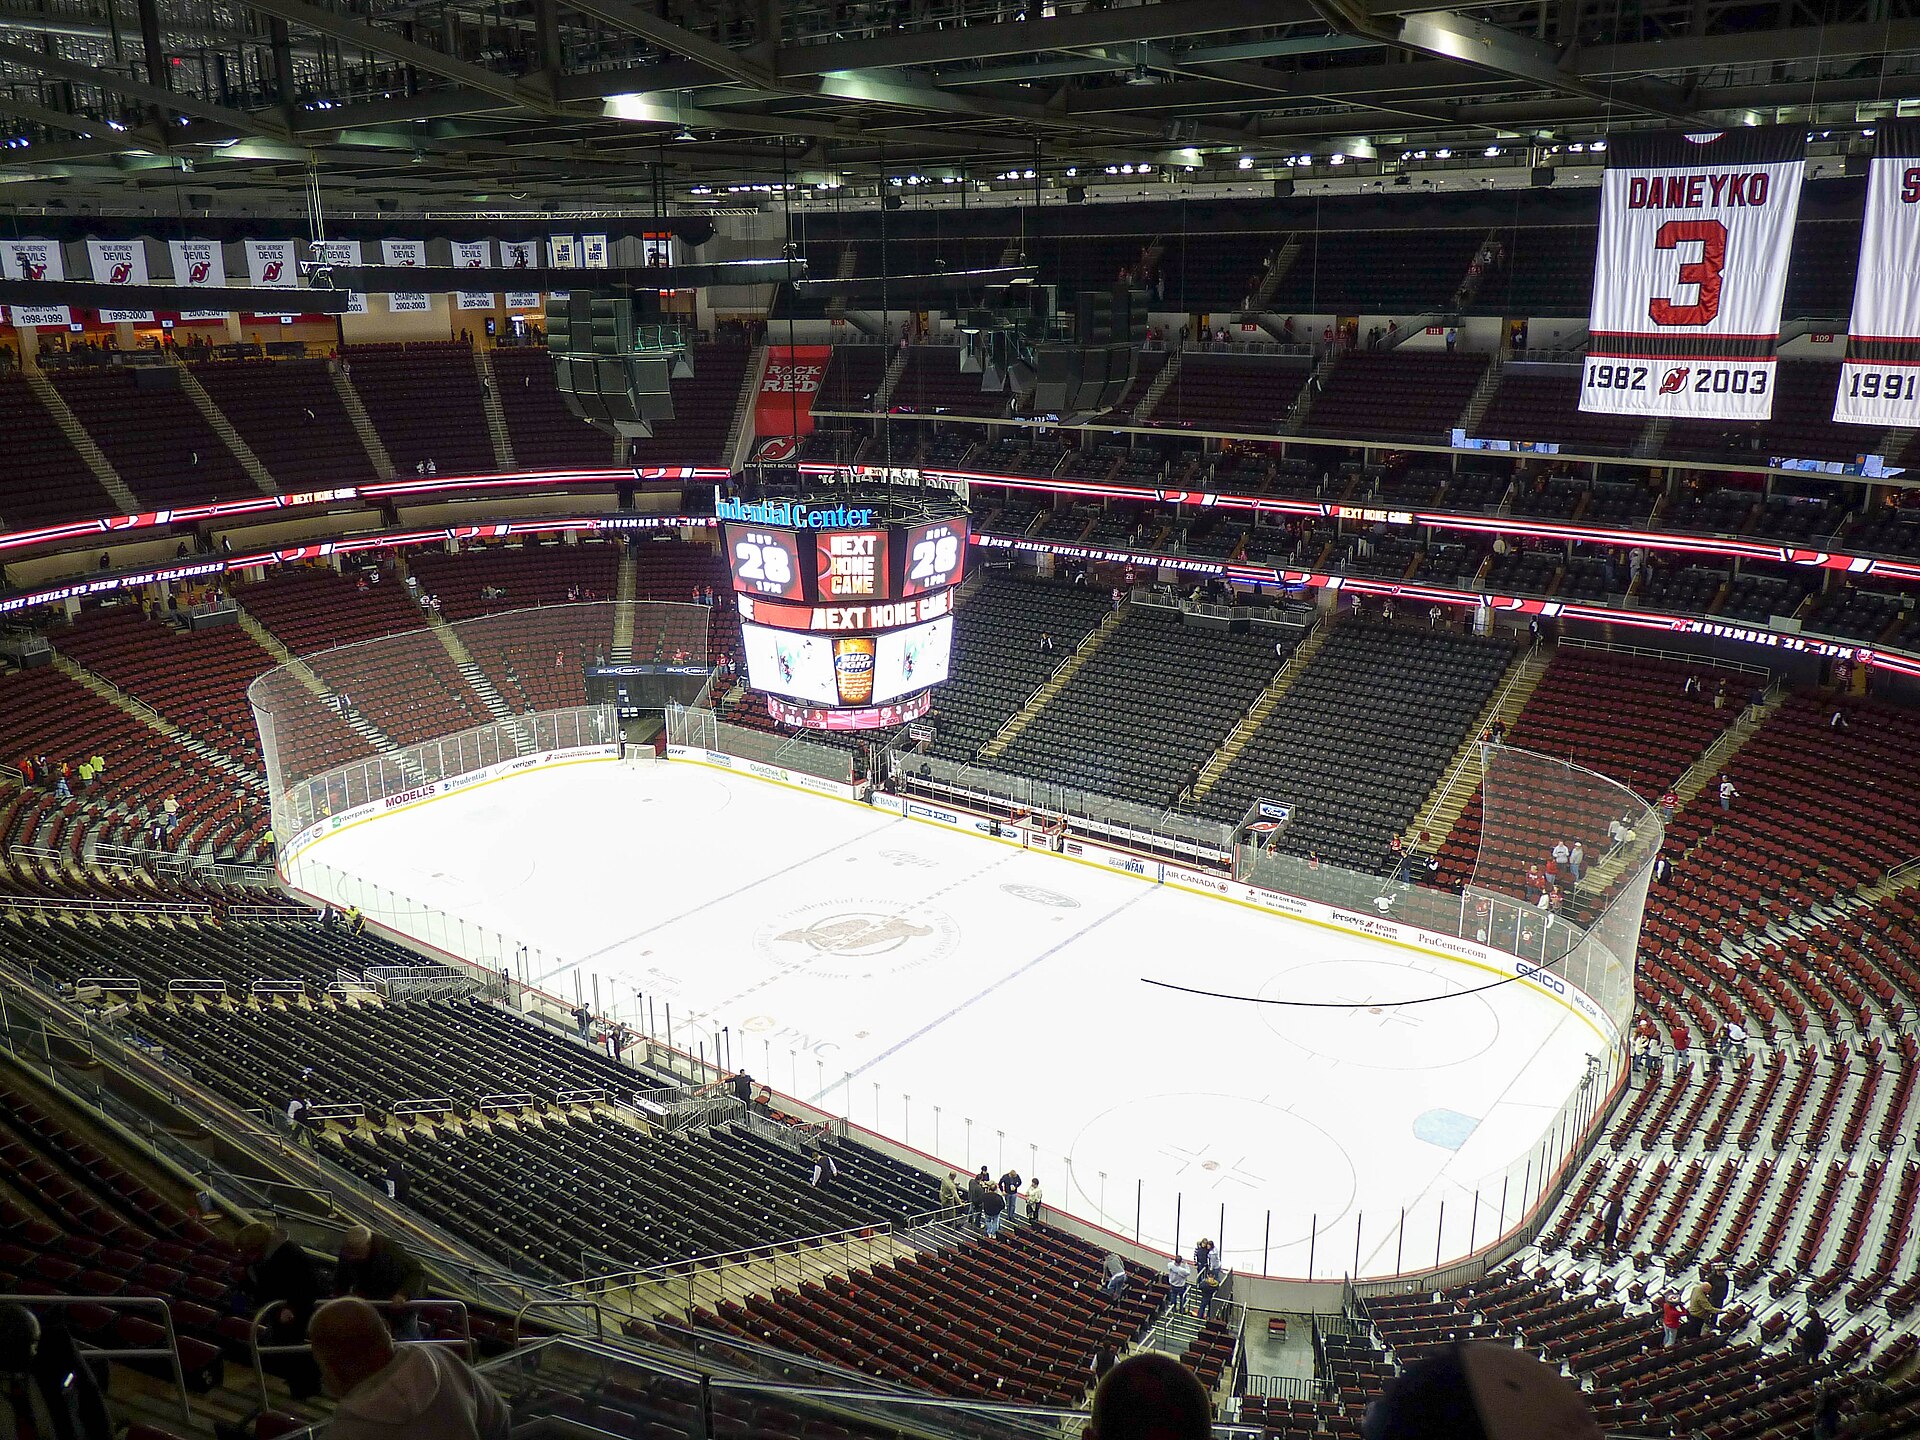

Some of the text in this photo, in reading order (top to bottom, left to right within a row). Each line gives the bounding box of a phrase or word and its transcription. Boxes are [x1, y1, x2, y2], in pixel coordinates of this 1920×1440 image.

[1629, 173, 1769, 209] DANEYKO
[104, 252, 132, 261] DEVILS
[184, 251, 210, 260] DEVILS
[258, 251, 283, 260] DEVILS
[328, 251, 350, 259] DEVILS
[394, 250, 415, 258] DEVILS
[462, 250, 481, 258] DEVILS
[557, 253, 570, 261] EAST
[589, 252, 602, 260] EAST
[1648, 219, 1728, 326] 3
[396, 302, 426, 310] 2002-2003
[21, 314, 63, 323] 1998-1999
[109, 311, 147, 320] 1999-2000
[767, 366, 821, 375] ROCK
[761, 380, 819, 392] RED
[1587, 364, 1768, 394] 1982 2003
[1850, 373, 1914, 400] 1991
[293, 492, 313, 504] NEXT
[314, 490, 334, 502] HOME
[718, 498, 872, 527] udential Center
[1339, 507, 1363, 520] NEXT
[1364, 509, 1388, 522] HOME
[925, 527, 951, 541] NOV.
[830, 536, 876, 556] NEXT
[735, 542, 790, 583] 28
[911, 536, 957, 580] 28
[992, 537, 1223, 574] NEW JERSEY DEVILS VS NEW YORK ISLANDERS
[831, 557, 875, 576] HOME
[27, 591, 68, 605] DEVILS
[71, 585, 88, 596] VS
[89, 580, 120, 592] NEW
[121, 574, 154, 586] YORK
[156, 563, 224, 580] ISLANDERS
[831, 576, 874, 594] GAME
[924, 573, 945, 587] 1PM
[756, 581, 782, 594] 1PM
[811, 607, 865, 629] NEXT
[871, 602, 916, 627] HOME
[1691, 622, 1854, 659] NOVEMBER 28, 1PM
[838, 660, 873, 669] LIGHT
[841, 654, 870, 662] BUD
[512, 759, 537, 769] verizon
[750, 764, 780, 776] QuickChek
[452, 771, 487, 787] Prudential
[386, 785, 435, 807] MODELL'S
[880, 797, 899, 808] BANK
[936, 813, 956, 822] PLUS
[1266, 808, 1282, 816] Ford
[1001, 828, 1015, 837] Ford
[1125, 860, 1145, 874] WFAN
[1166, 871, 1216, 889] AIR CANADA
[1261, 892, 1278, 900] PLEASE
[1332, 911, 1365, 926] jerseys
[1376, 923, 1398, 934] team
[1418, 933, 1487, 960] PruCenter.com
[1516, 962, 1565, 995] GEICO
[1574, 995, 1597, 1018] NHL.COM
[774, 1027, 840, 1057] PNC
